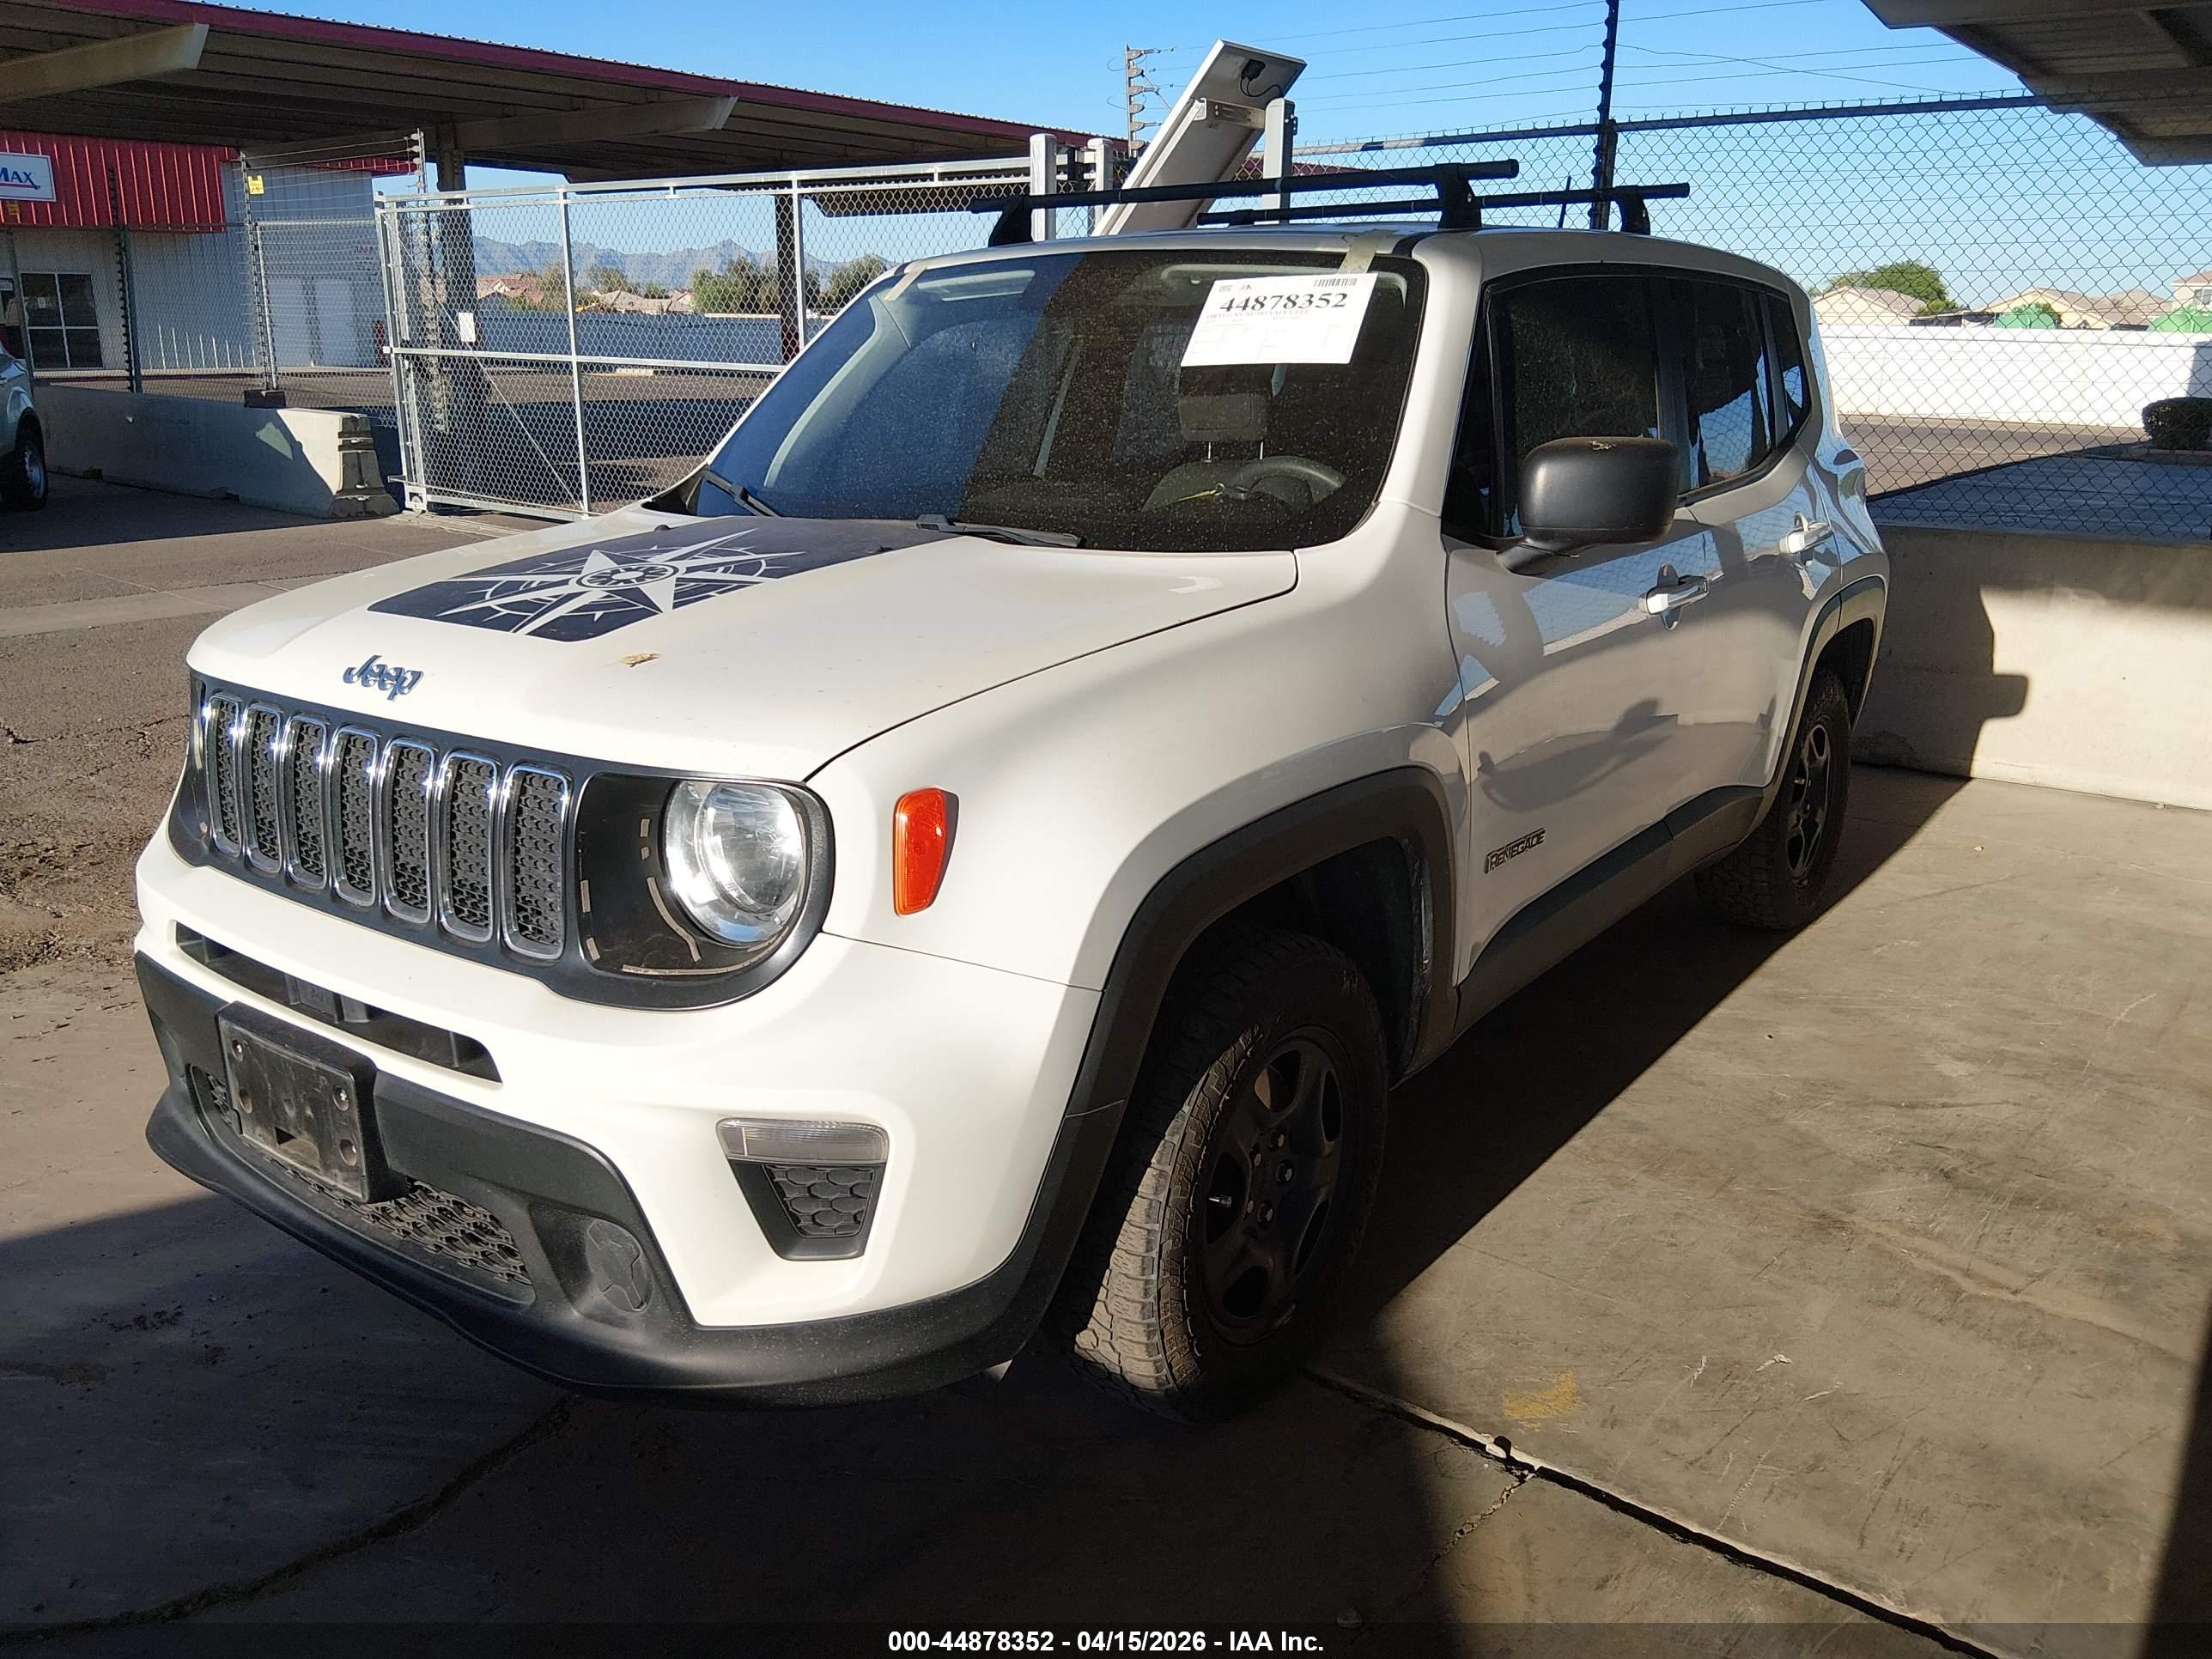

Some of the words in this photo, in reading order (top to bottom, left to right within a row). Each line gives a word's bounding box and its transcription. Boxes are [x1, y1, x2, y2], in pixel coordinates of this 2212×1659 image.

[1218, 293, 1349, 312] 44878352
[343, 654, 424, 701] Jeep
[1484, 827, 1547, 873] RENEGADE
